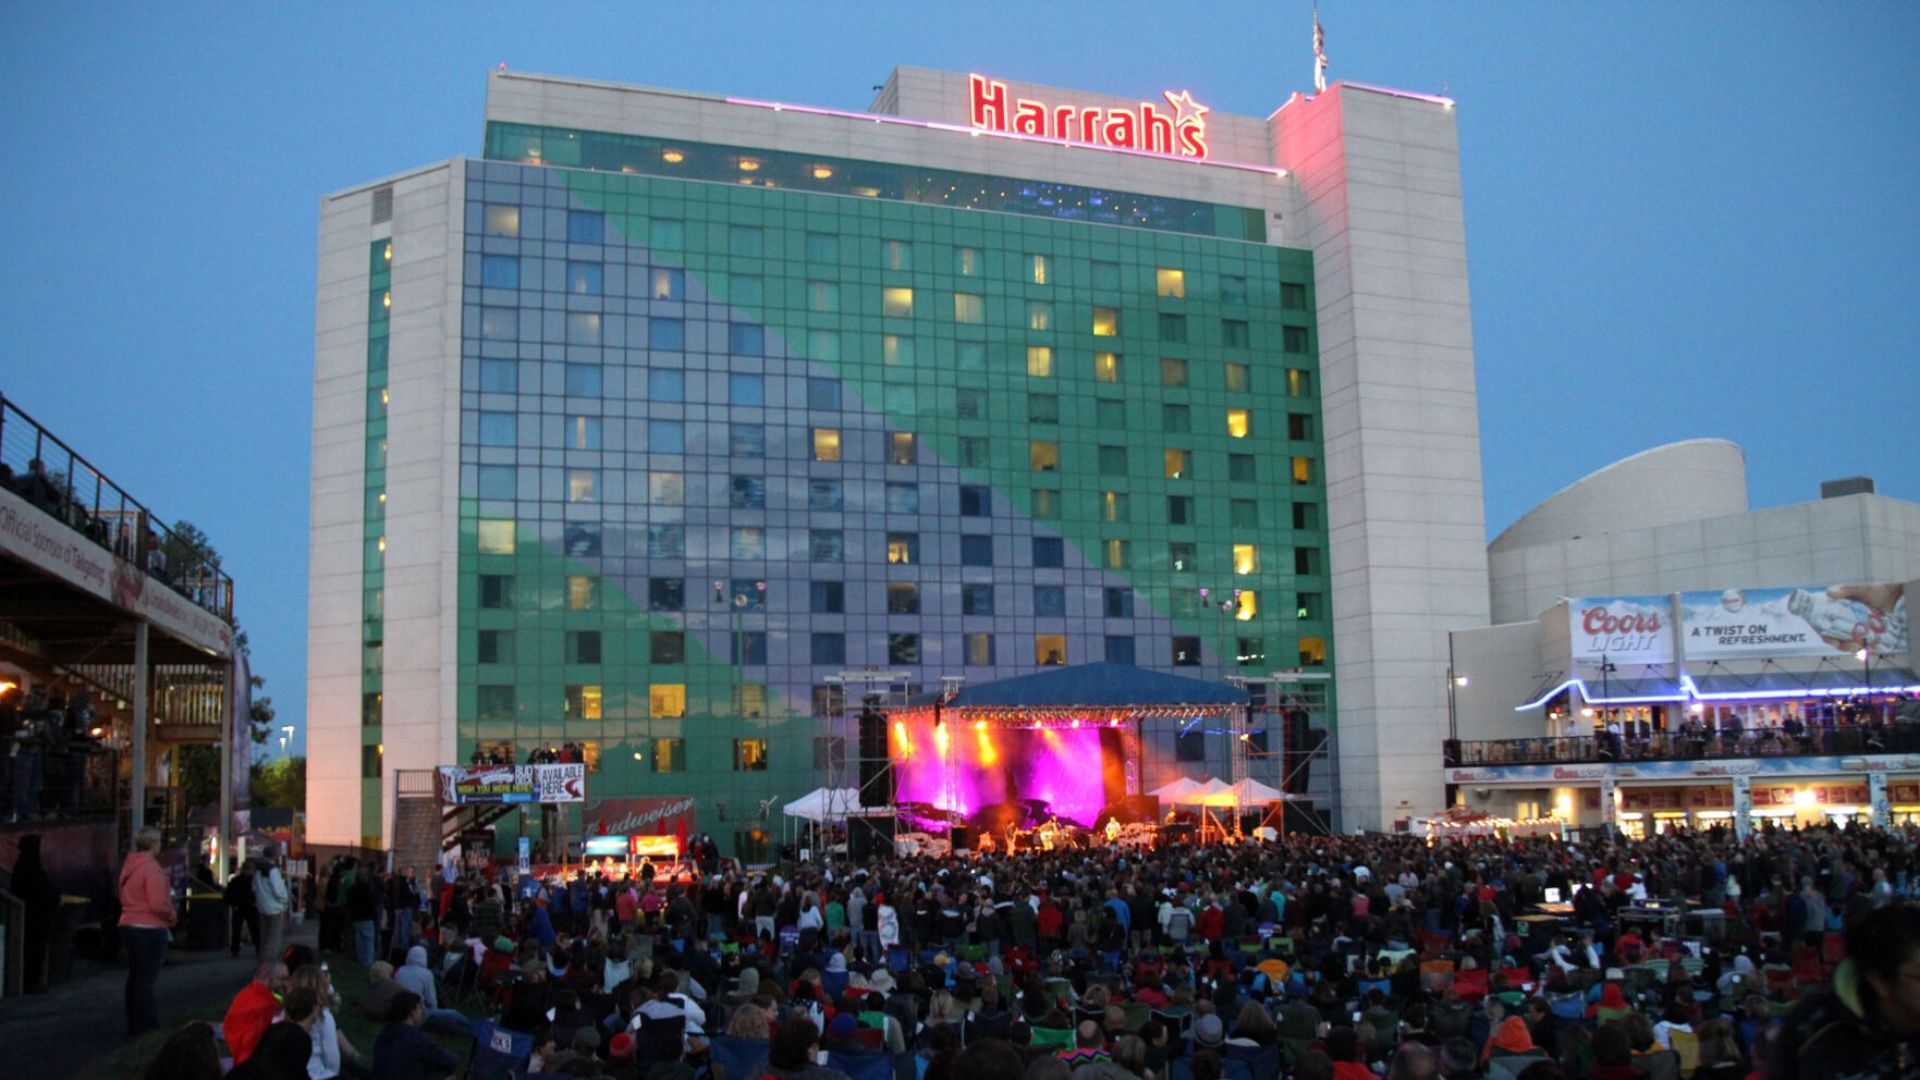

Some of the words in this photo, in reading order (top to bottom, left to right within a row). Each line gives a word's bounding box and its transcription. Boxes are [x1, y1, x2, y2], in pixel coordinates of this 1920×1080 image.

[1581, 606, 1661, 635] Coors
[1691, 627, 1701, 638] A
[1704, 624, 1744, 636] TWIST
[1748, 624, 1768, 635] ON
[1586, 633, 1658, 652] LIGHT
[515, 764, 533, 775] BUD
[542, 765, 583, 781] AVAILABLE
[542, 780, 564, 795] HERE
